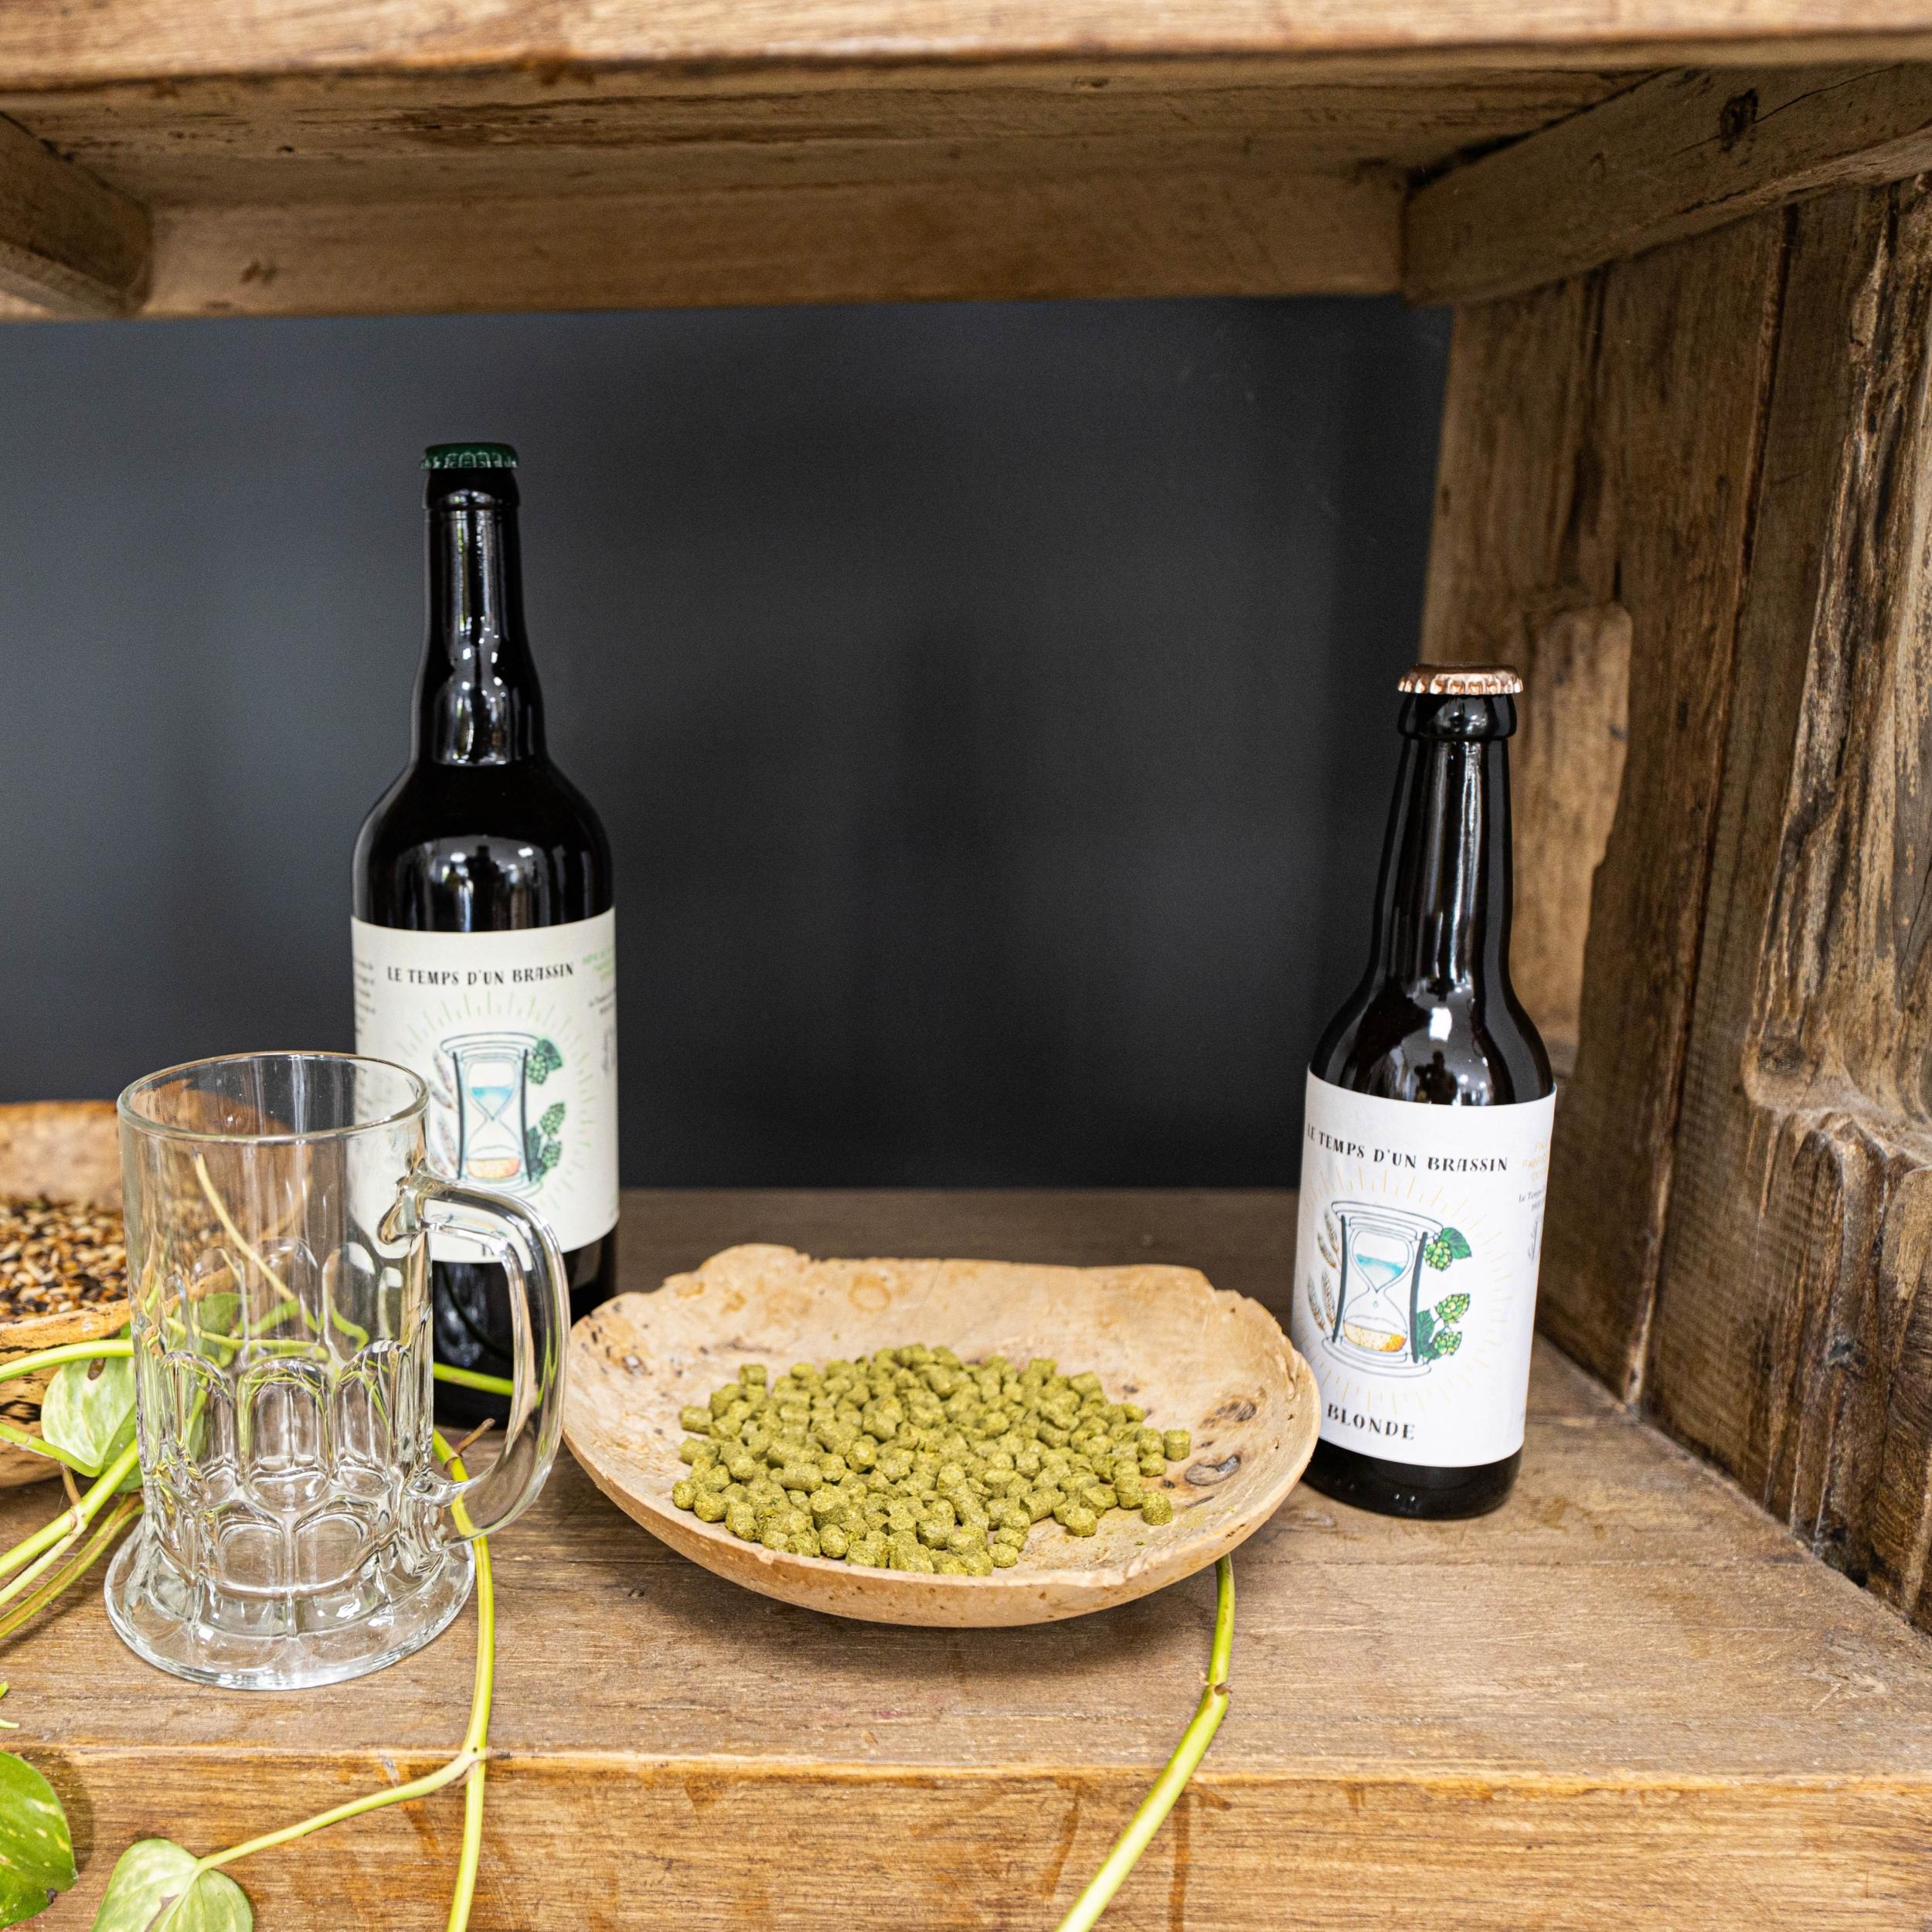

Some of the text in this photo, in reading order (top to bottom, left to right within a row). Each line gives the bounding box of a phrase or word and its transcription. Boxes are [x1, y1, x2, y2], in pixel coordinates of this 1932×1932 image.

[387, 966, 401, 981] LE
[408, 968, 459, 985] TEMPS
[468, 969, 504, 985] D'UN
[512, 963, 574, 982] BRASSIN
[1308, 1123, 1315, 1141] LE
[1318, 1131, 1365, 1158] TEMPS
[1373, 1148, 1417, 1169] D'UN
[1427, 1156, 1507, 1172] BRASSIN
[1328, 1402, 1415, 1440] BLONDE
